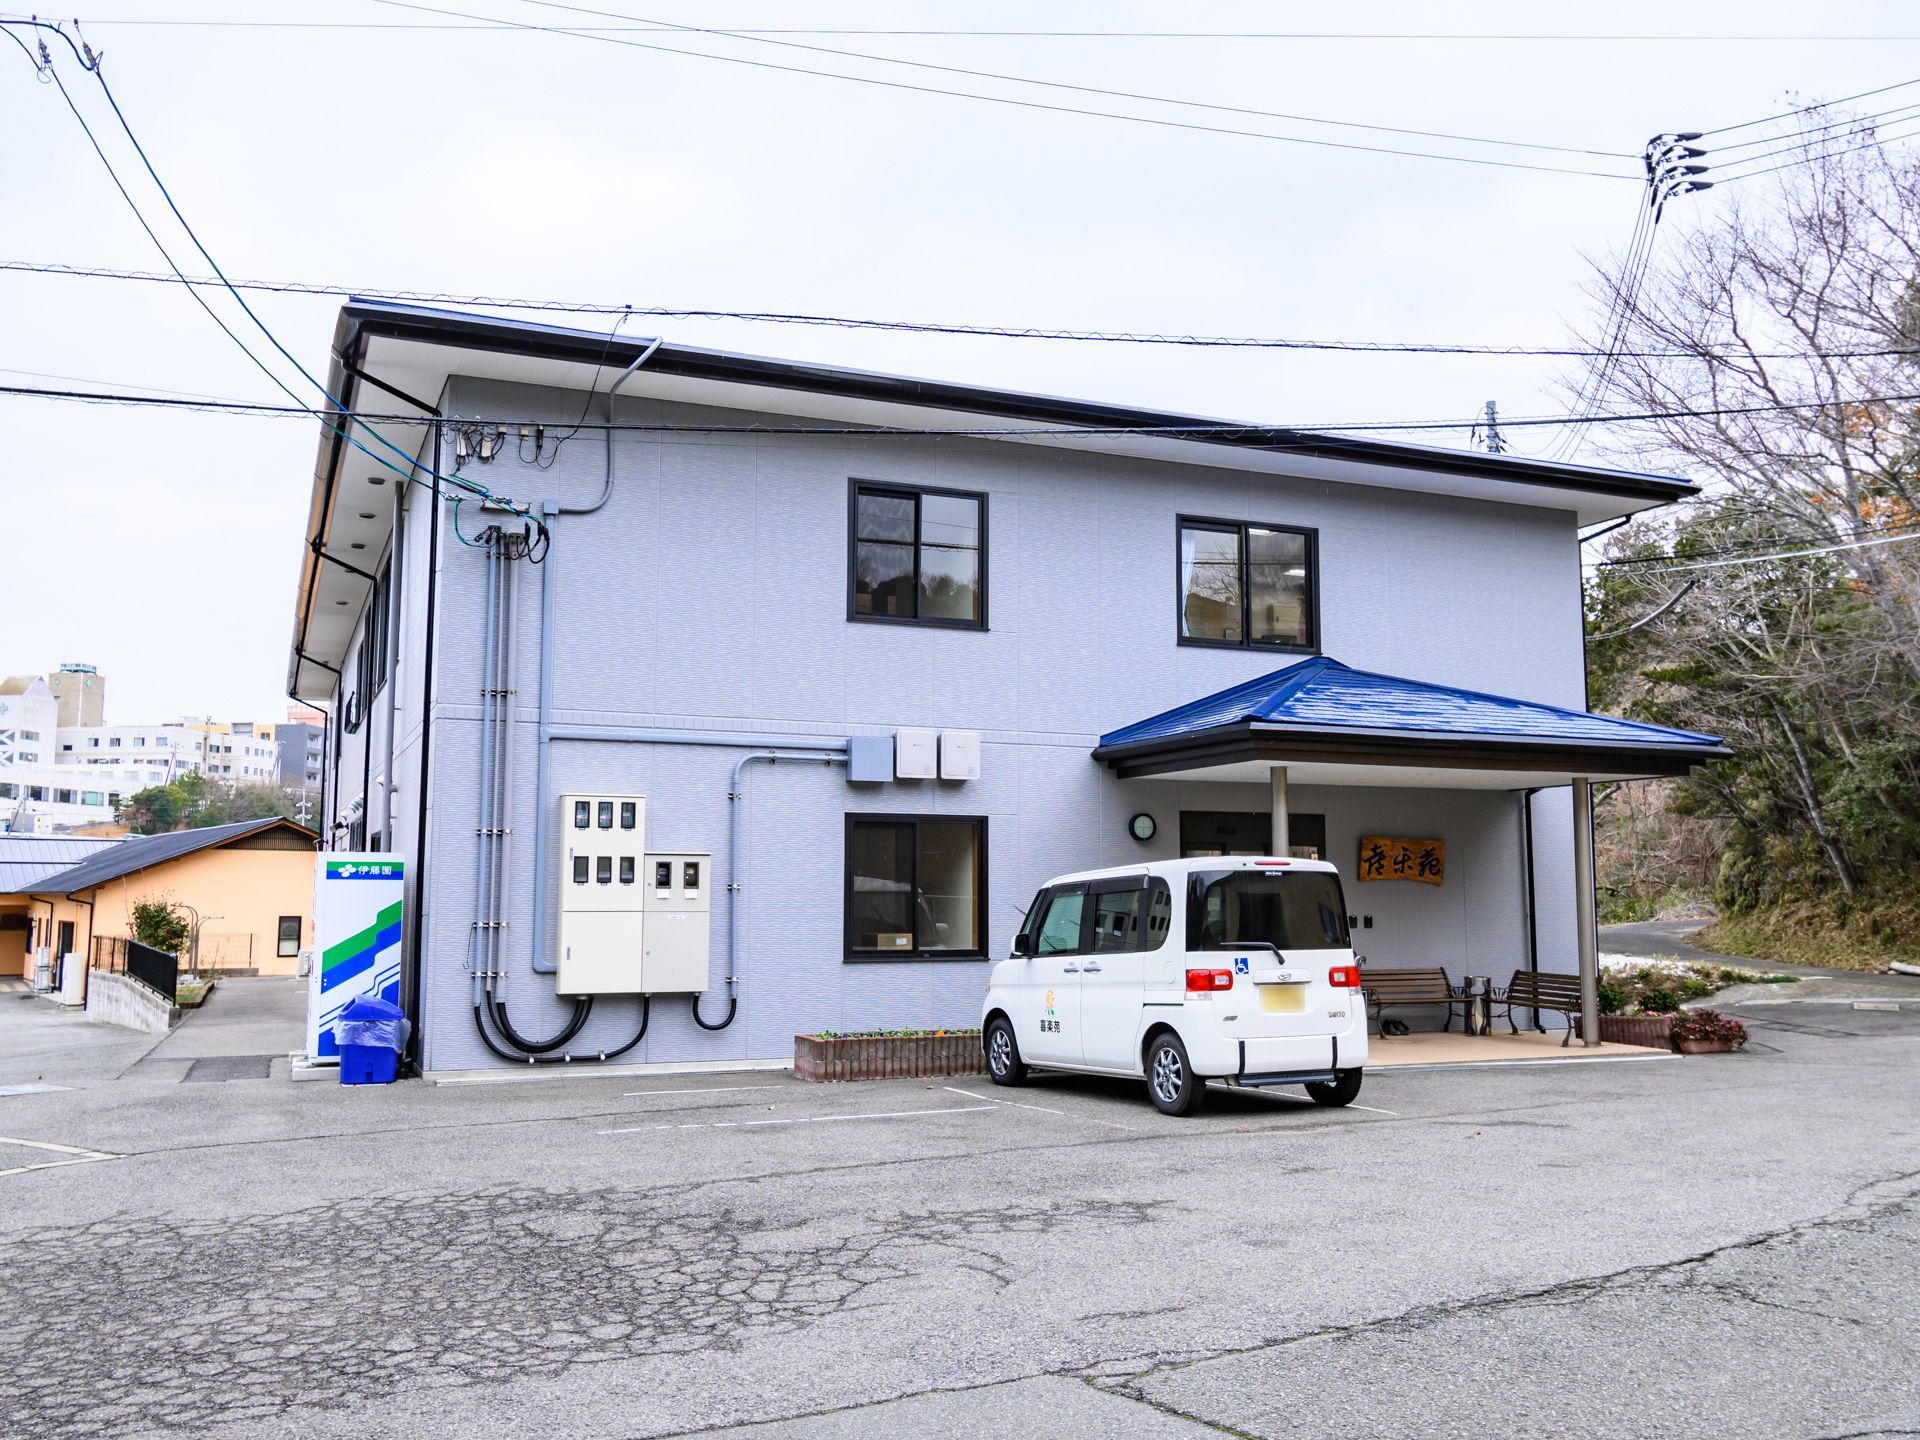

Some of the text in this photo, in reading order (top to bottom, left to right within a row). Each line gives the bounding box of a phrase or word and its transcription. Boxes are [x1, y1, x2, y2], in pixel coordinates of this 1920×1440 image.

[358, 865, 392, 875] 伊藤園
[1040, 1019, 1060, 1033] 喜楽苑
